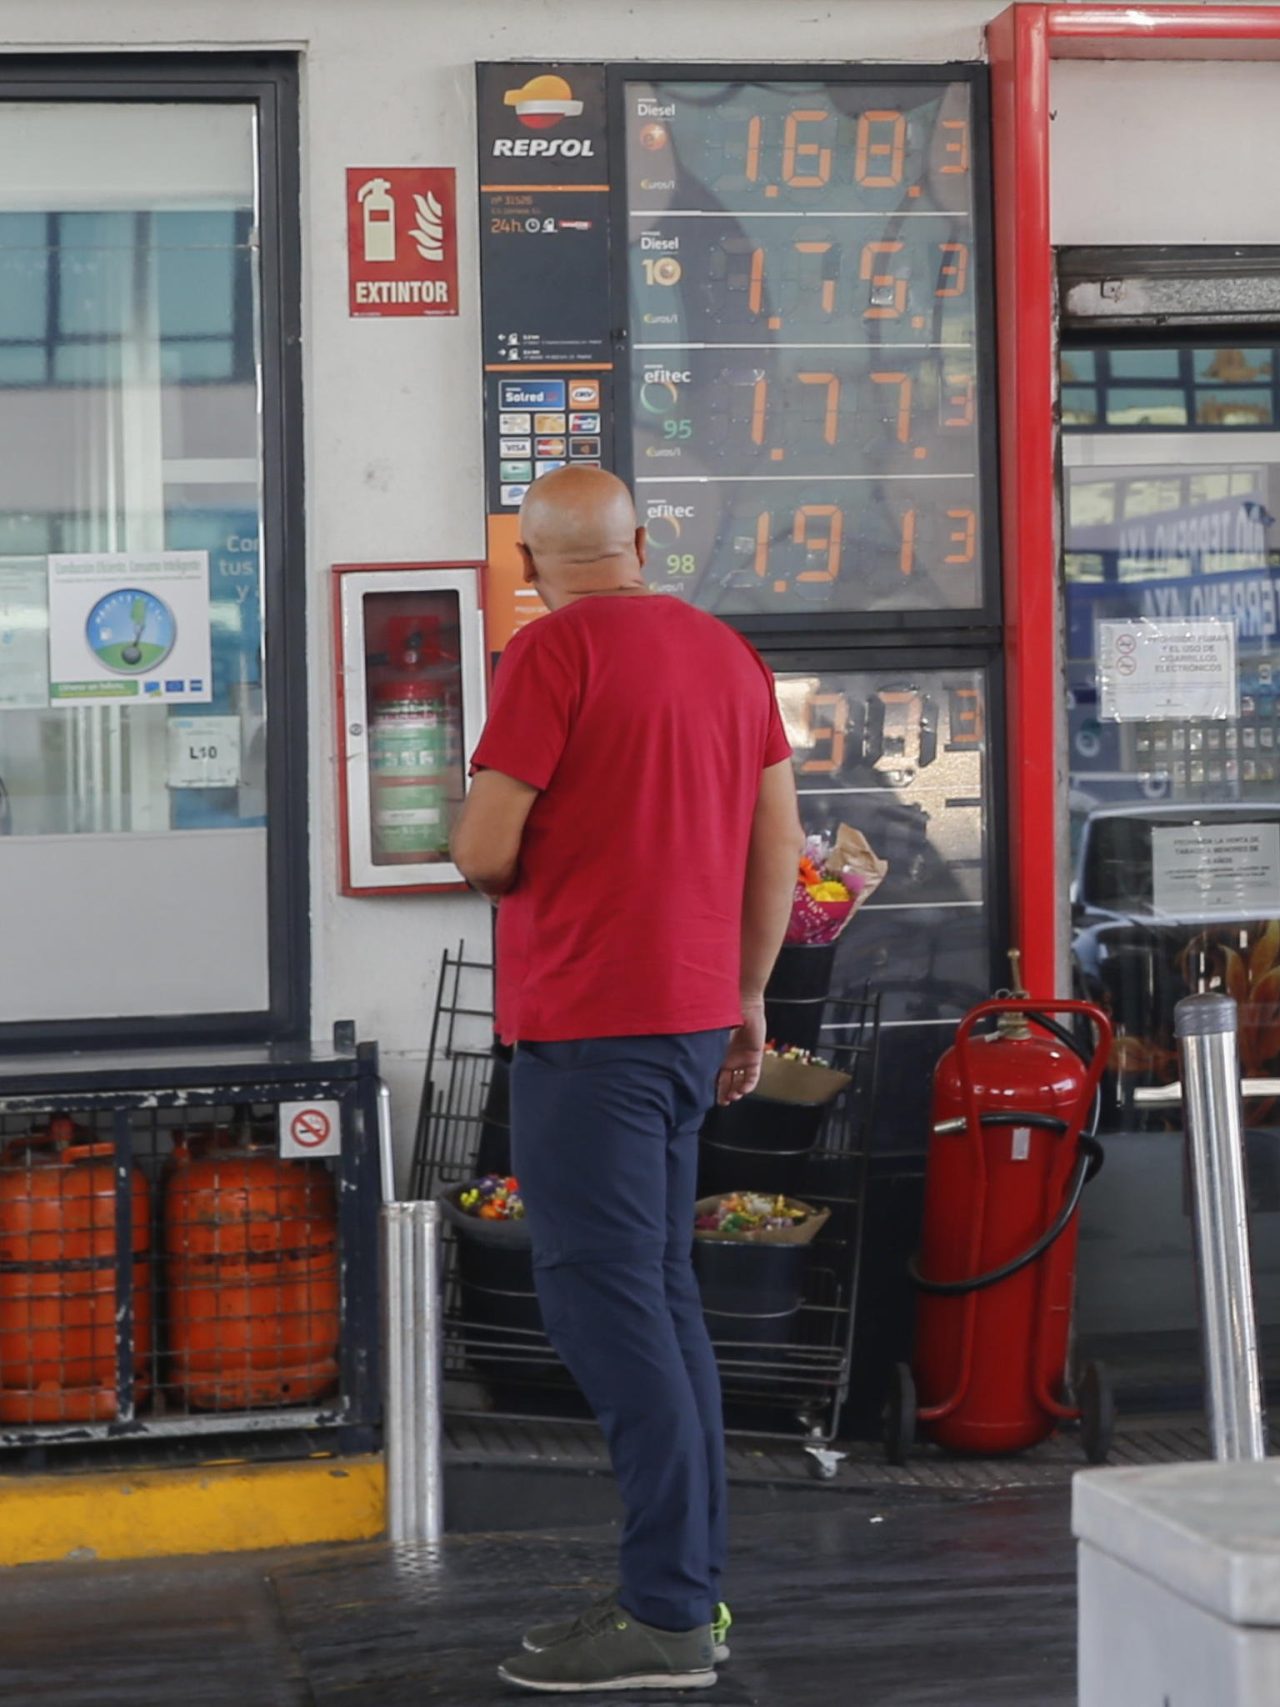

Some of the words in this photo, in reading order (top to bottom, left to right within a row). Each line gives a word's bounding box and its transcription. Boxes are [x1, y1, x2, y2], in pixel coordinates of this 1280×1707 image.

[637, 103, 676, 117] Diesel
[493, 139, 595, 157] REPSOL
[640, 236, 679, 251] Diesel
[355, 280, 449, 304] EXTINTOR
[643, 369, 692, 384] efitec
[505, 391, 545, 403] Solred
[663, 418, 693, 440] 95
[646, 503, 696, 519] efitec
[219, 558, 254, 577] tus
[666, 553, 696, 575] 98
[189, 745, 218, 760] L10
